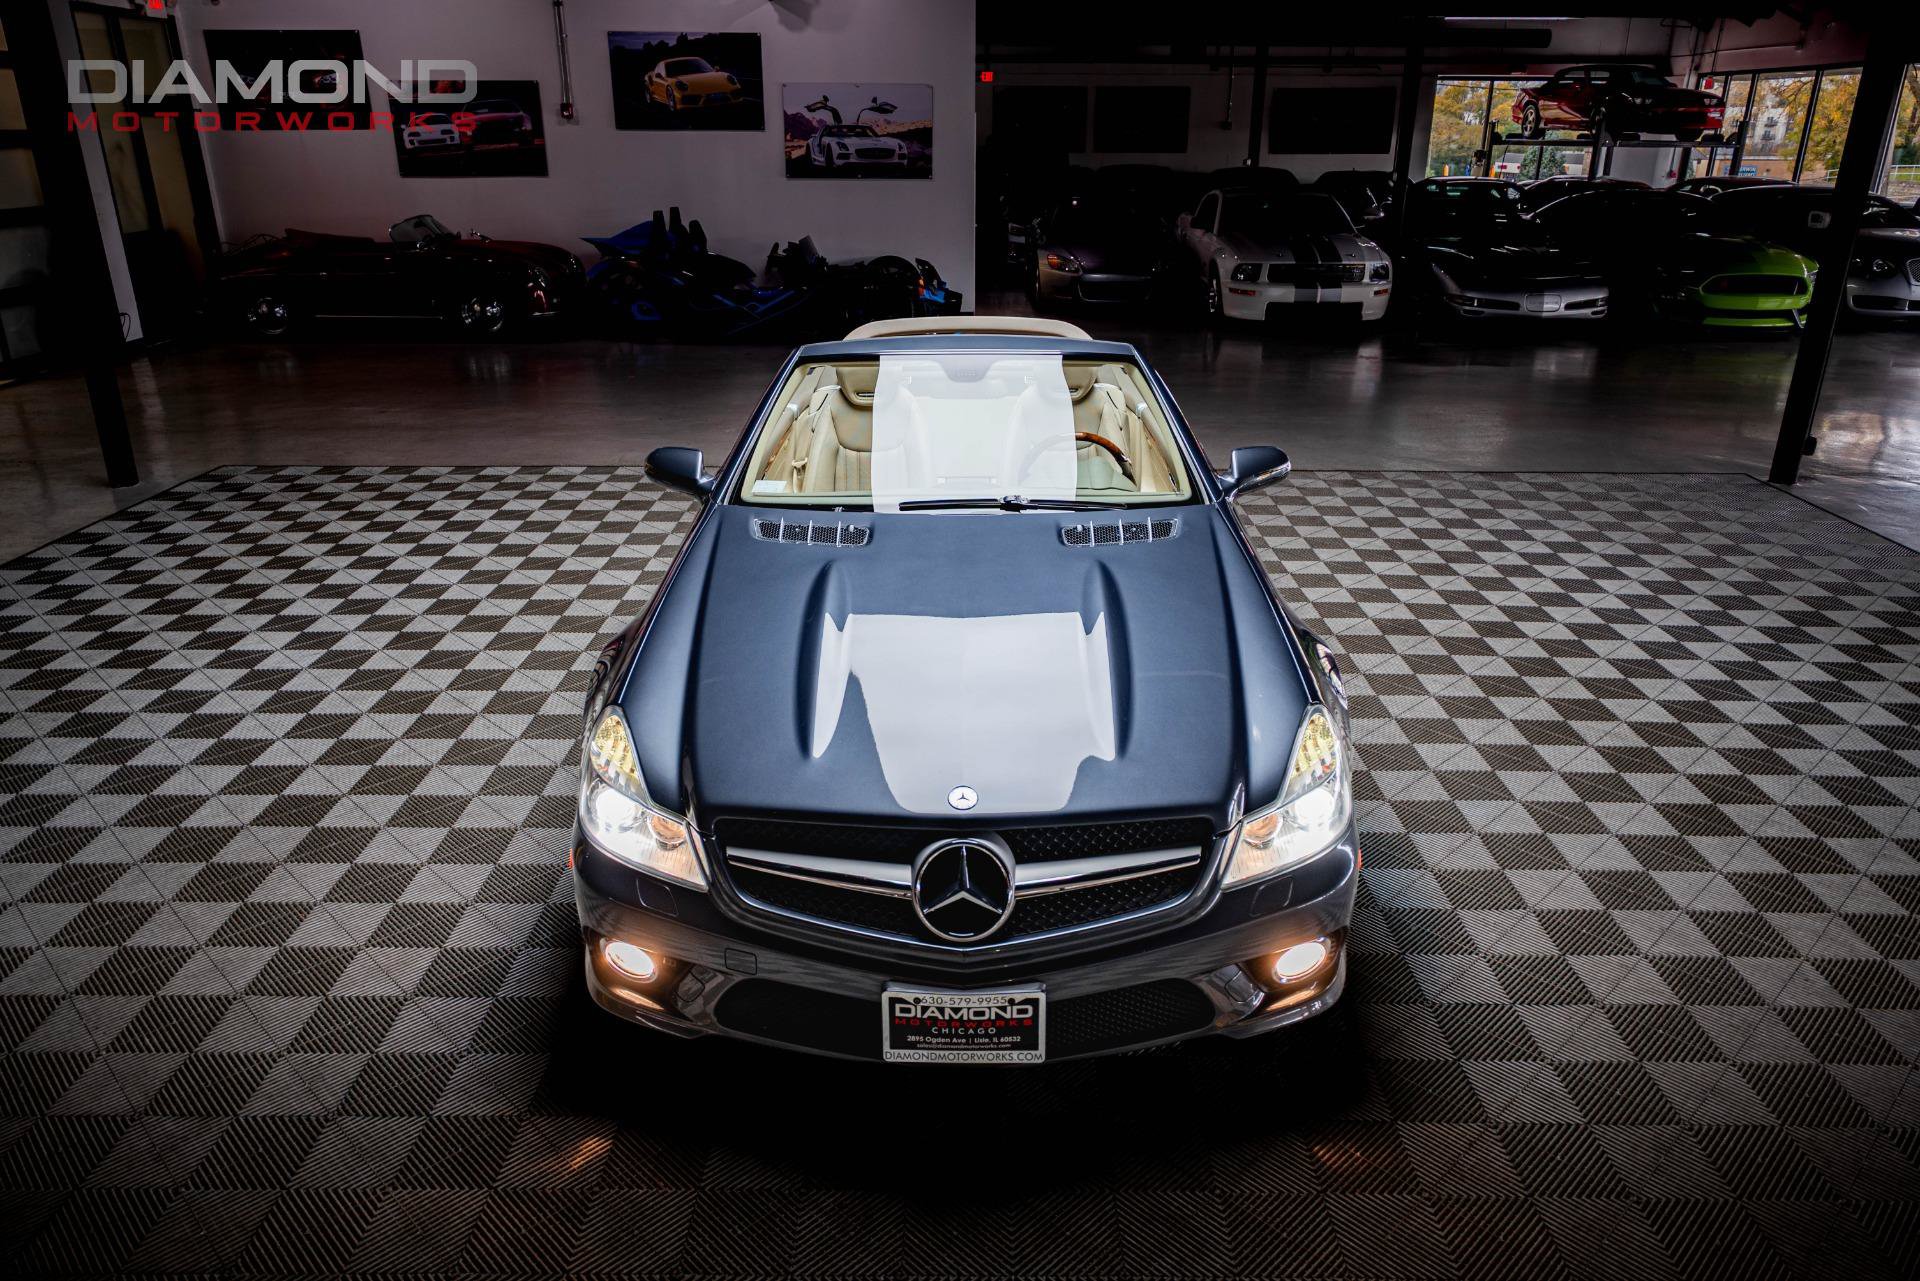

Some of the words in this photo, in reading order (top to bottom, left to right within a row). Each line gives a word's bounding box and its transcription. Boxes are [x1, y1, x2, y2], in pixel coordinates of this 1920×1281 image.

[921, 996, 1007, 1006] 630-579-9955
[895, 1004, 1033, 1020] DIAMOND
[895, 1019, 1033, 1028] MOTORWORKS
[931, 1027, 997, 1035] CHICAGO
[925, 1036, 951, 1044] Ogden
[885, 1052, 1043, 1061] DIAMONDMOTORWORKS.COM
